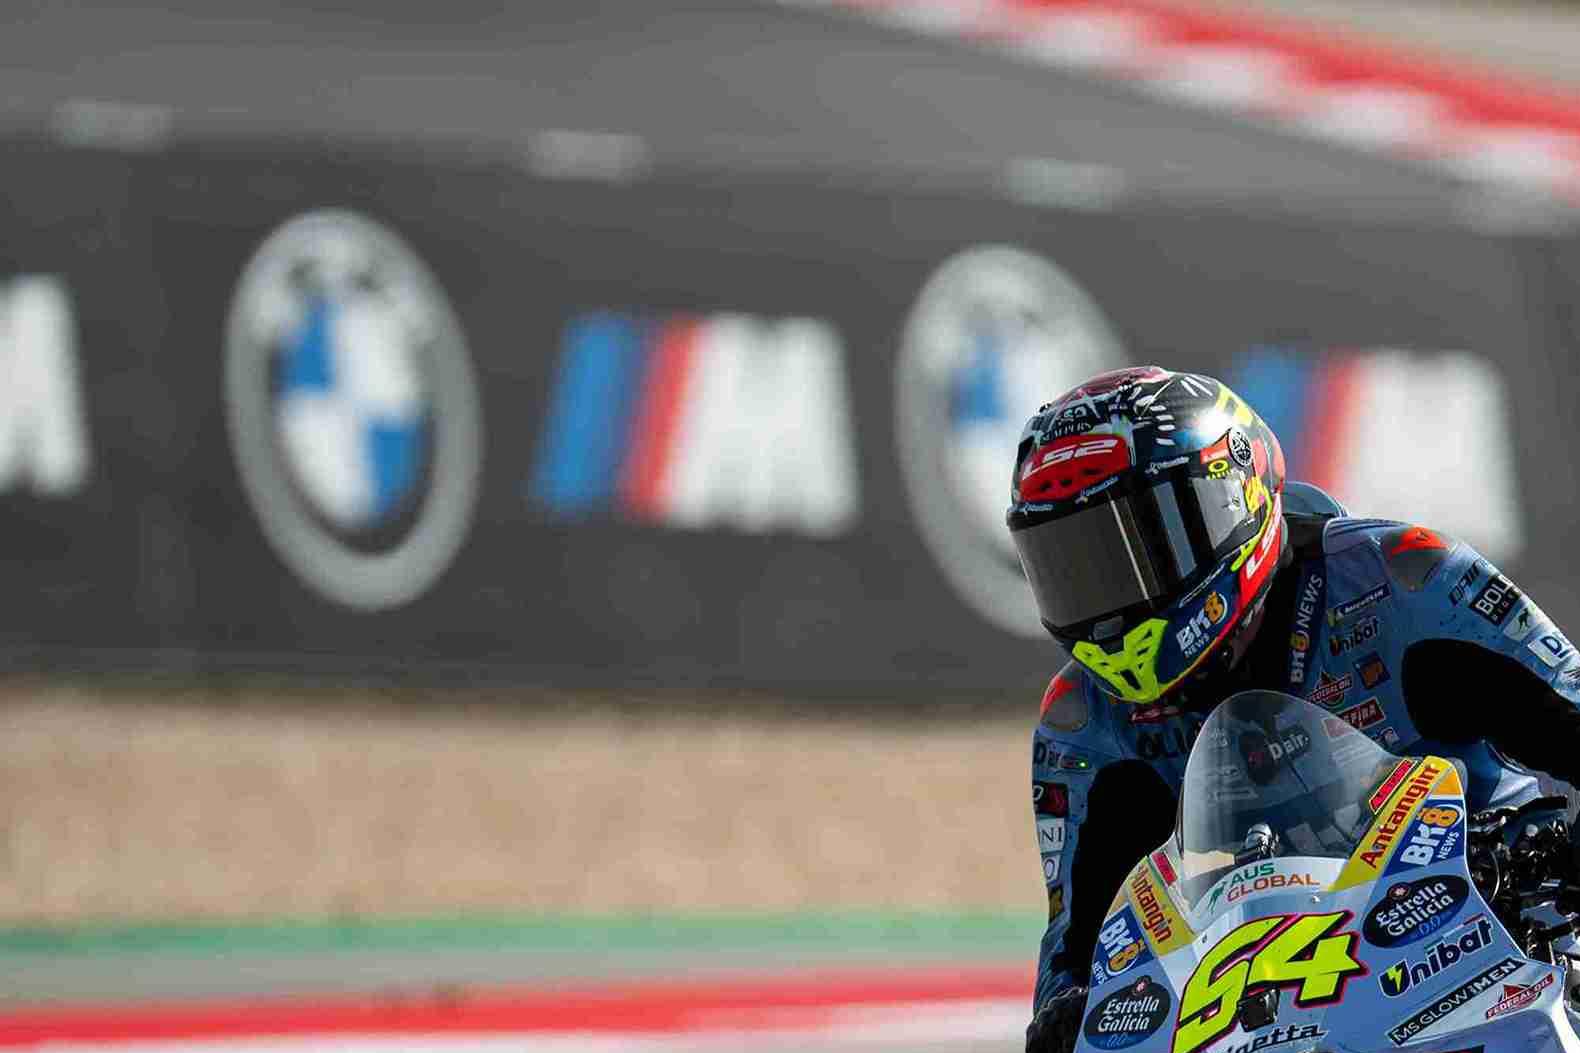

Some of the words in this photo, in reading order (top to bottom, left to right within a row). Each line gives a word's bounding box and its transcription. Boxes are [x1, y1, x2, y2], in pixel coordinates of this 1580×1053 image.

[1022, 439, 1118, 481] LS2
[1297, 573, 1324, 630] NEWS
[1474, 575, 1517, 616] BOL
[1358, 765, 1441, 870] Antangin
[1437, 830, 1460, 860] NEWS
[1226, 872, 1321, 903] GLOBAL
[1230, 863, 1275, 887] AUS
[1375, 881, 1447, 928] Estrella
[1387, 894, 1454, 937] Galicia
[1377, 917, 1494, 998] Unibat
[1097, 1012, 1151, 1034] Galicia
[1105, 994, 1161, 1015] Estrella
